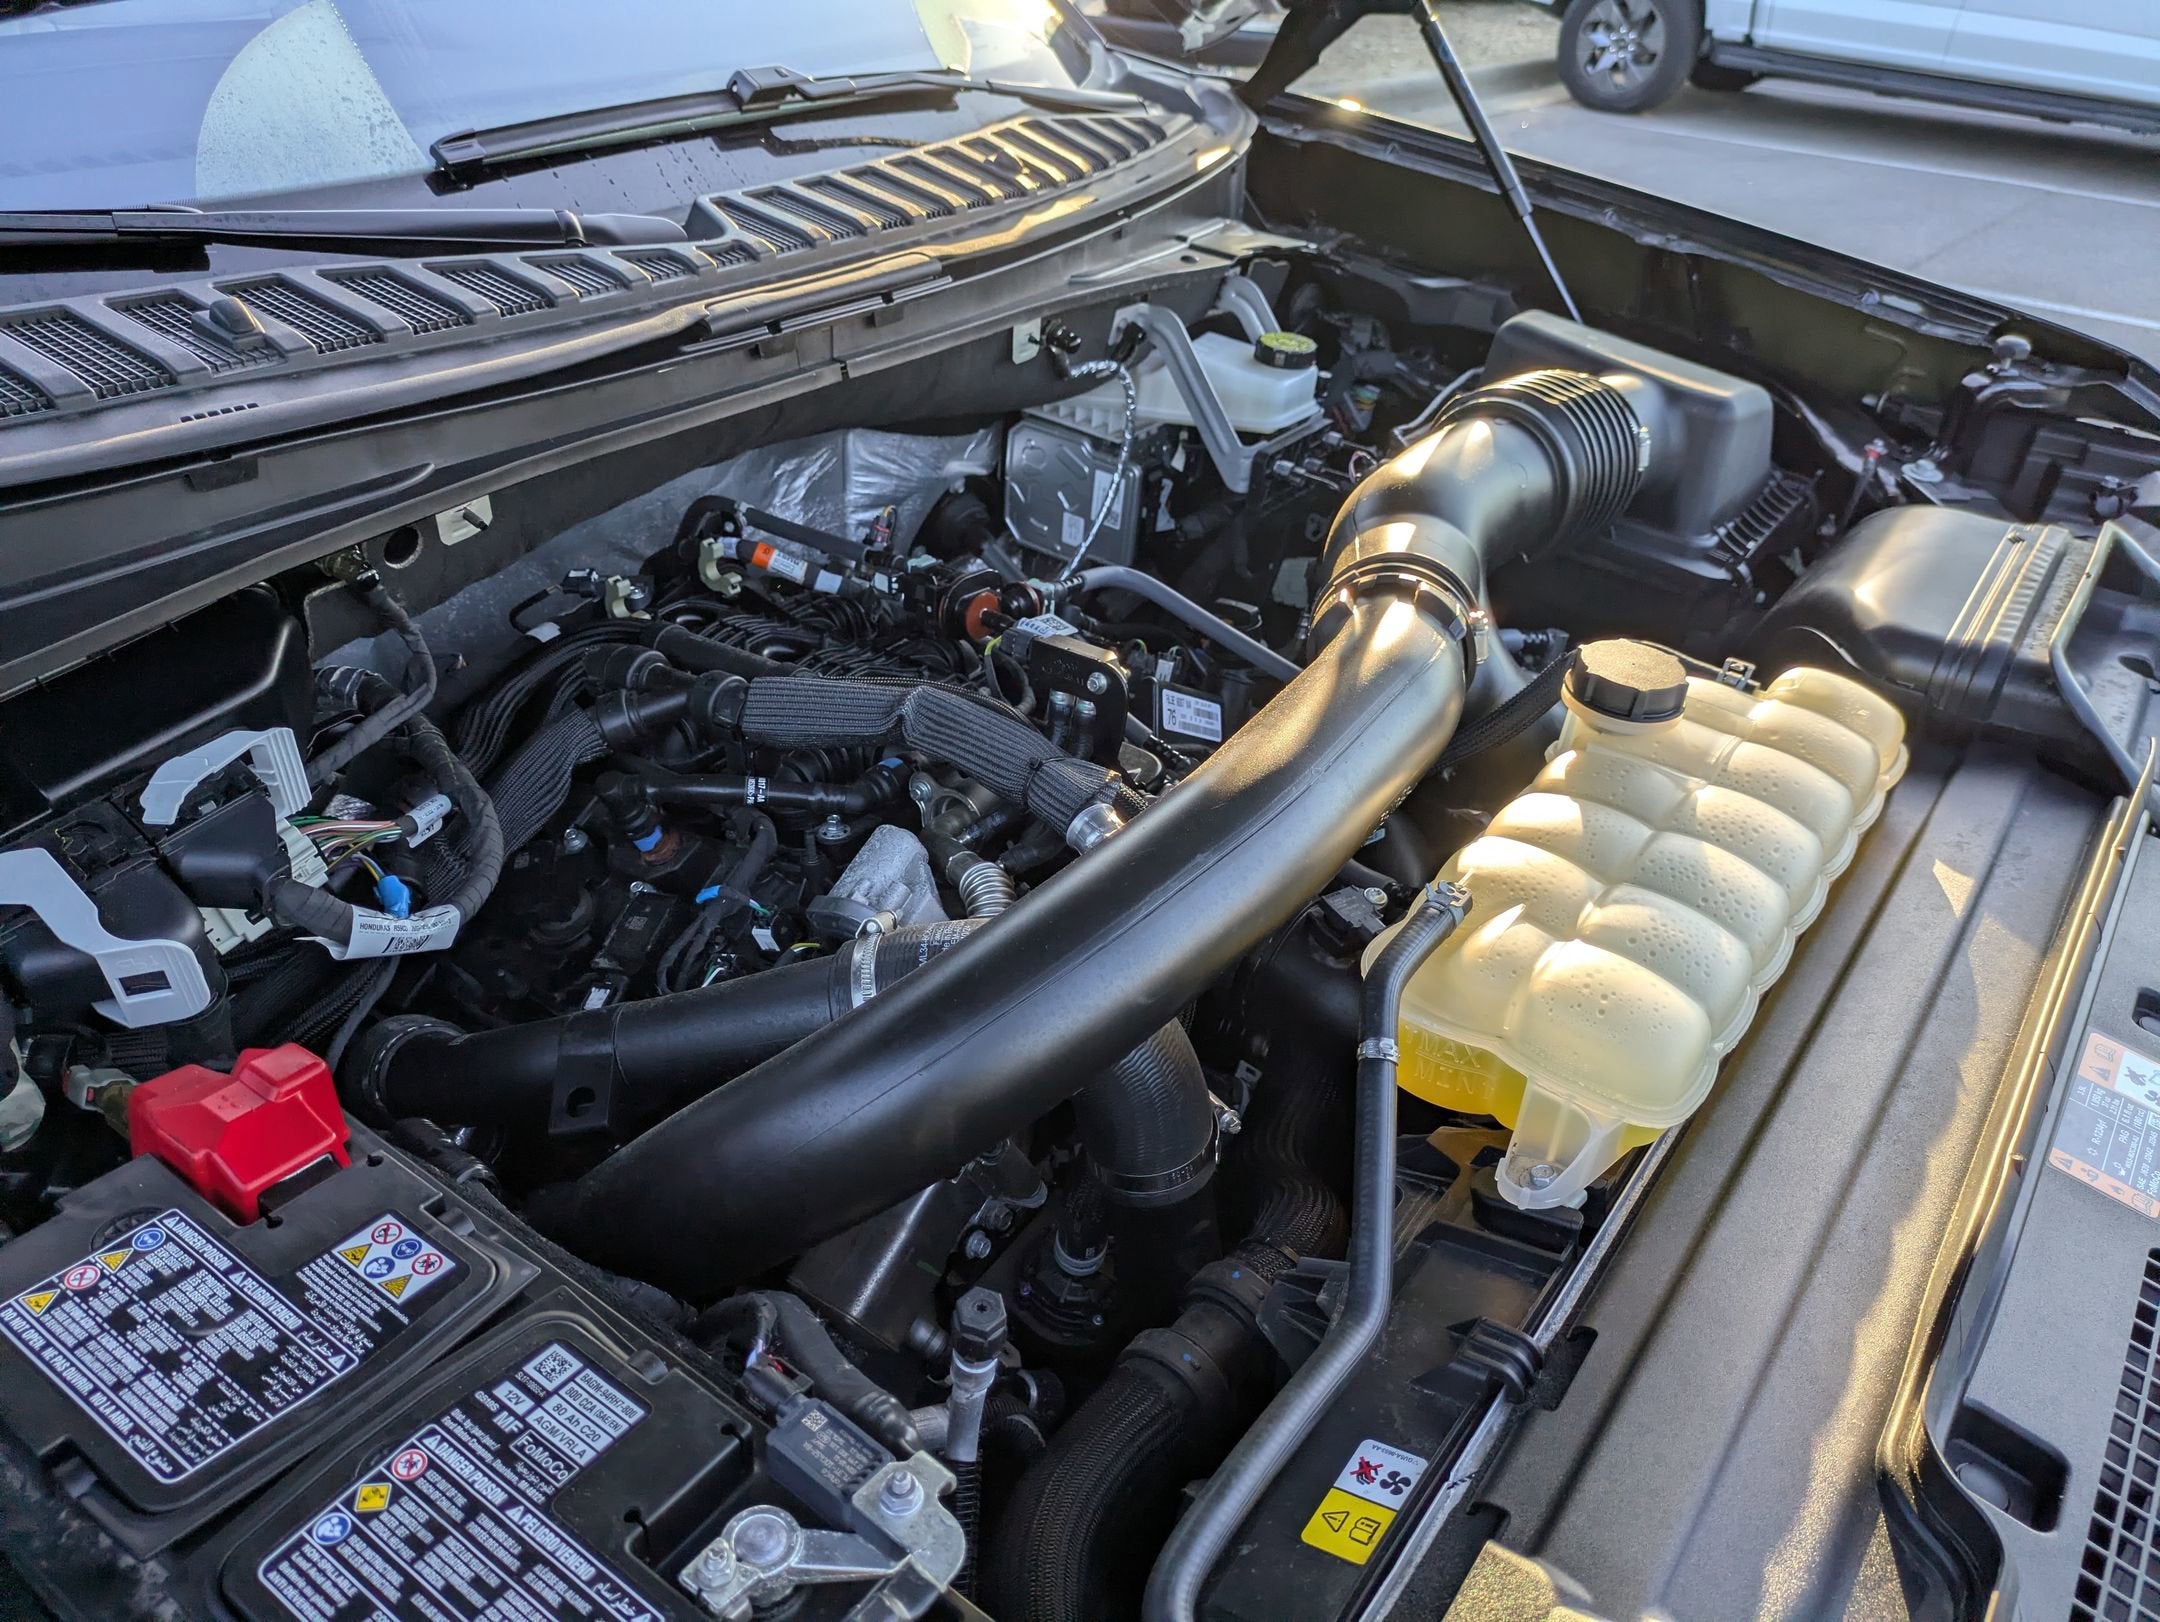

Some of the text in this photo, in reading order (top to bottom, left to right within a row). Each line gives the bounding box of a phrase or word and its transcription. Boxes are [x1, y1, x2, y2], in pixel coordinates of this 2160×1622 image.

[1419, 1030, 1483, 1068] MAX
[1414, 1058, 1475, 1095] MIN
[2118, 1129, 2130, 1145] PAG
[2145, 1168, 2160, 1198] FoMoCo
[172, 1222, 232, 1270] DANGER/POISON
[238, 1278, 302, 1329] PELIGRO/VENENO
[0, 1307, 46, 1351] DO NOT OPEN.
[41, 1346, 59, 1361] NE
[50, 1355, 71, 1372] PAS
[62, 1367, 94, 1396] OUVRIR.
[89, 1392, 134, 1435] NO LA ABRA.
[504, 1390, 526, 1406] 12V
[564, 1386, 623, 1432] 800 CCA (SAE/EN)
[493, 1411, 524, 1432] MF
[533, 1416, 586, 1459] AGM/VRLA
[552, 1403, 602, 1443] 80 Ah C20
[434, 1443, 507, 1504] DANGER/POISON
[516, 1435, 569, 1480] FoMoCo
[517, 1514, 595, 1580] PELIGRO/VENENO
[295, 1544, 364, 1597] NON-SPILLABLE
